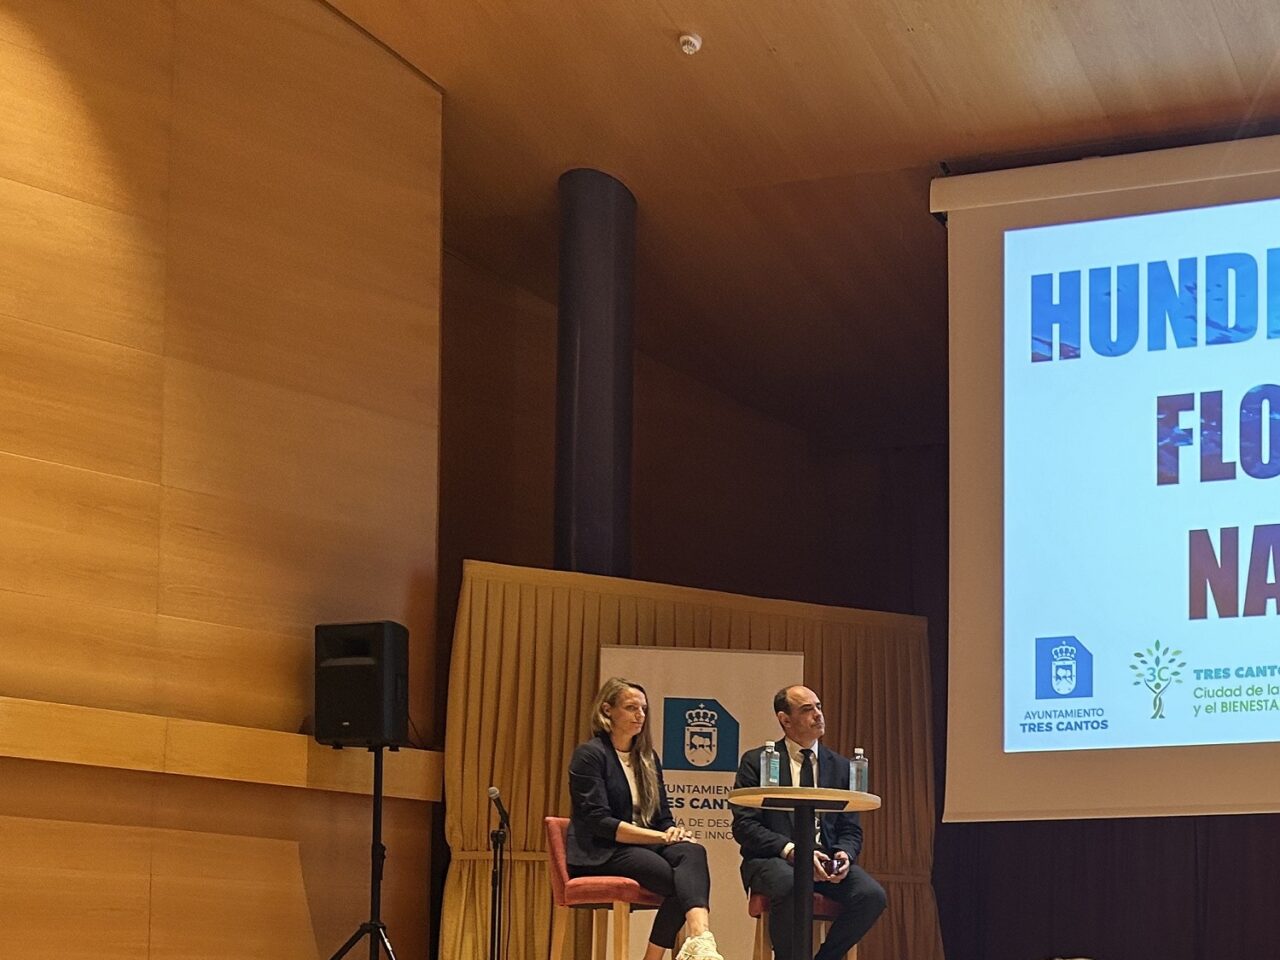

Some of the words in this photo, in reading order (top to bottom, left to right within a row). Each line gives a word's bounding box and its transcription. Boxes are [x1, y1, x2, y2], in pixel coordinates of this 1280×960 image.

[1146, 666, 1169, 682] 3C
[1193, 667, 1231, 681] TRES
[1193, 685, 1242, 699] Ciudad
[1248, 684, 1264, 697] de
[1267, 683, 1280, 696] la
[1024, 708, 1104, 721] AYUNTAMIENTO
[1193, 704, 1201, 717] y
[1204, 702, 1217, 714] el
[1020, 721, 1053, 733] TRES
[1056, 719, 1109, 732] CANTOS
[664, 784, 735, 795] UNTAMIEN
[667, 797, 685, 809] ES
[690, 798, 731, 810] CANT
[708, 818, 732, 828] DES
[705, 831, 734, 840] INNO
